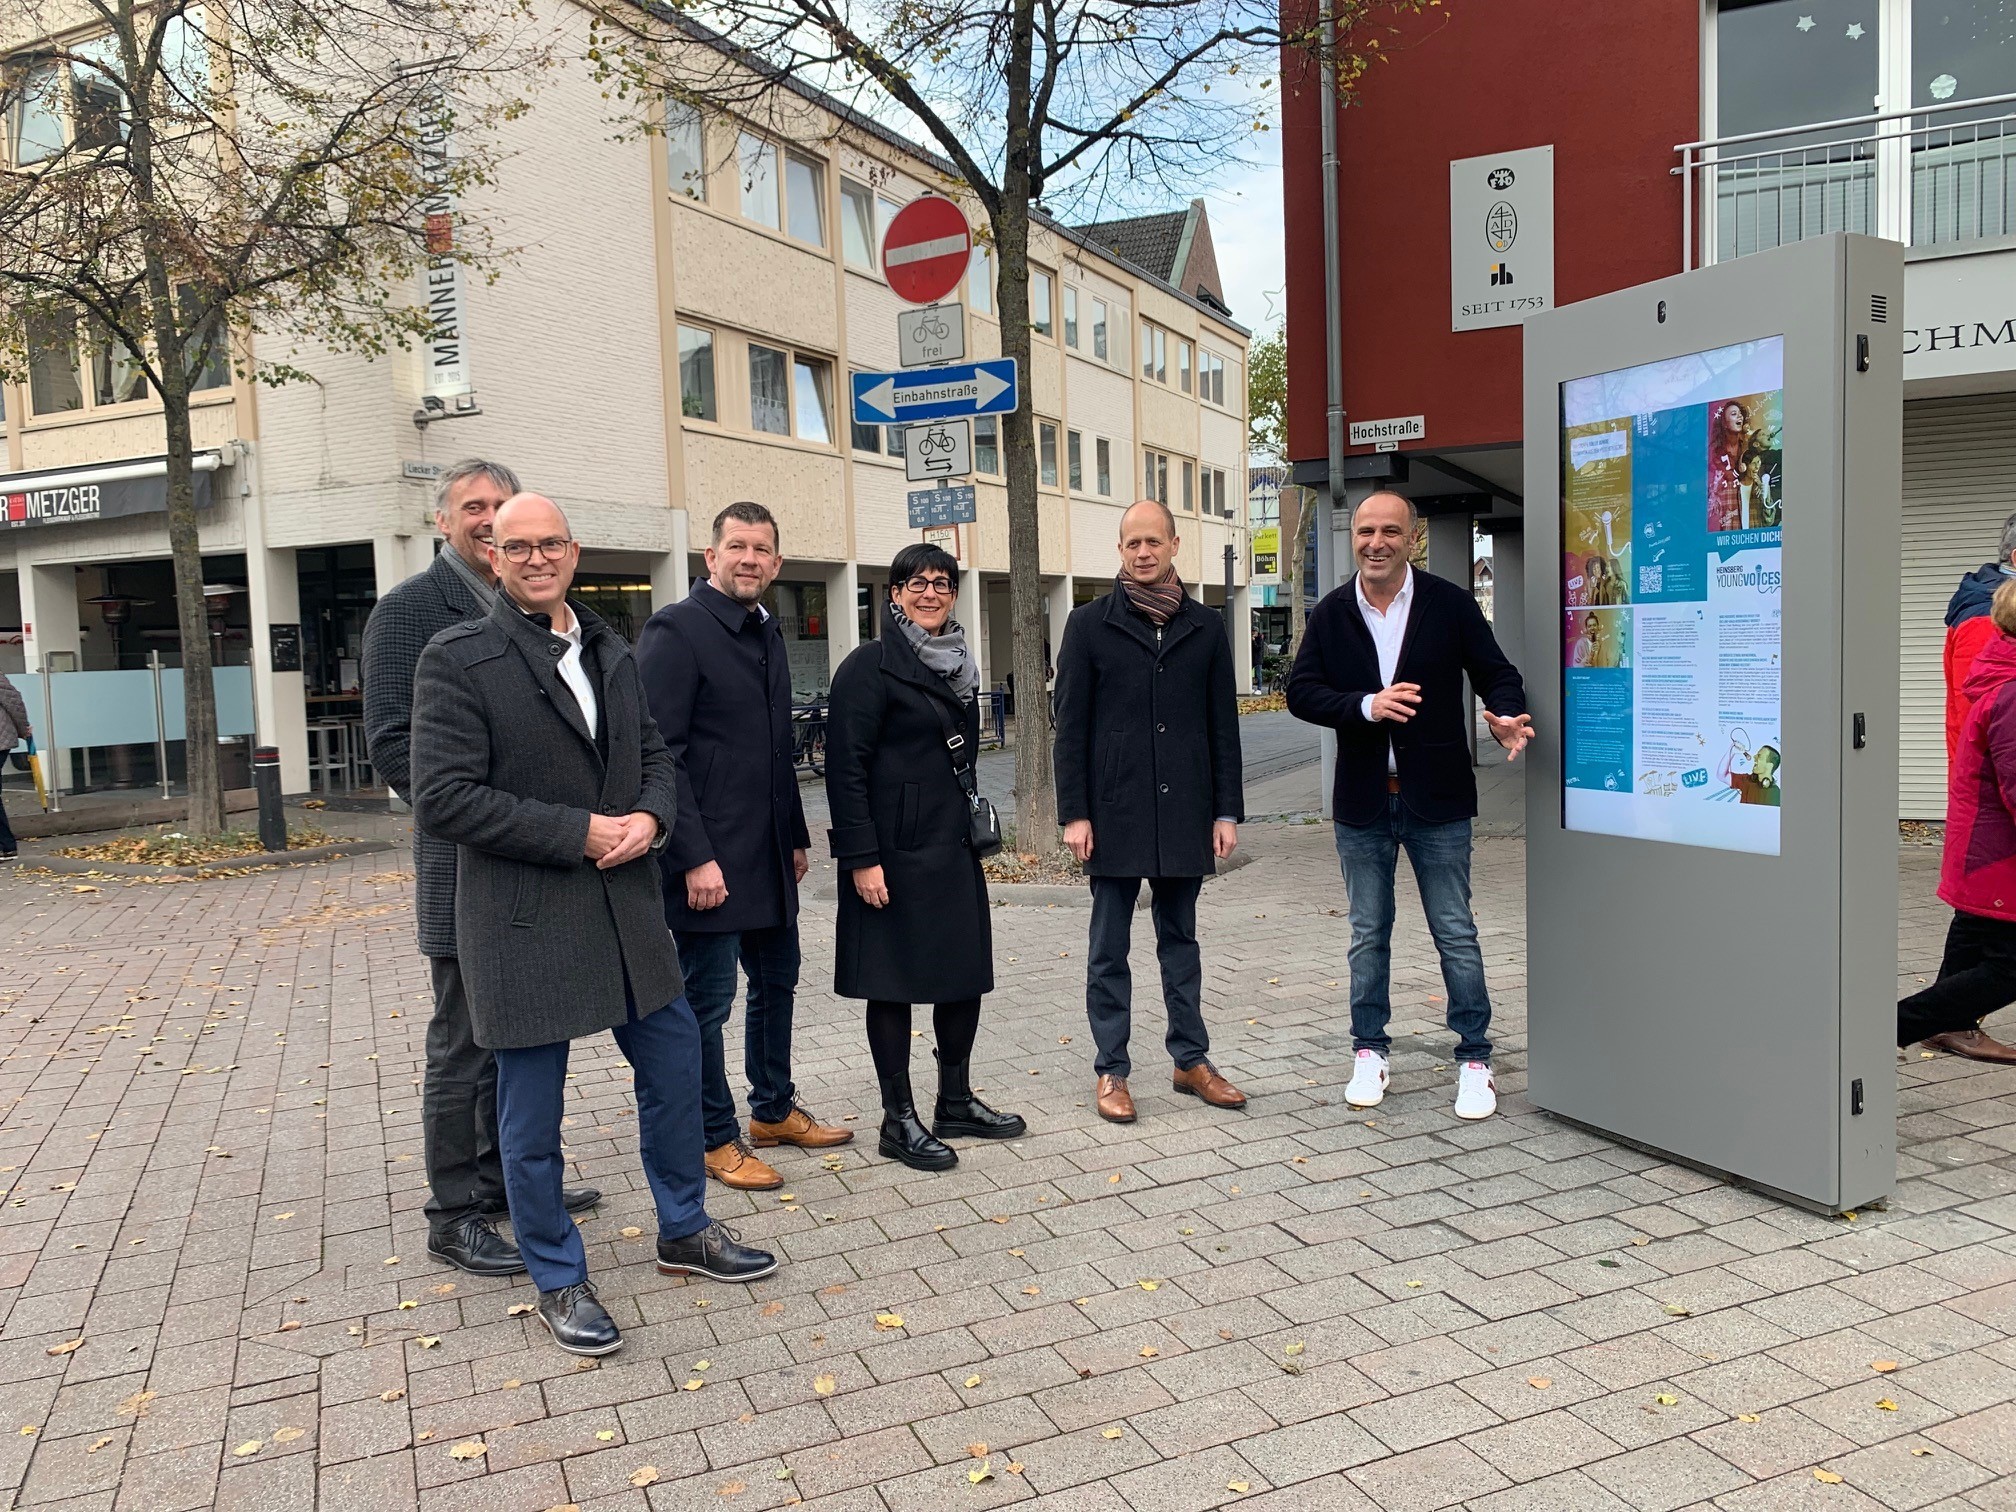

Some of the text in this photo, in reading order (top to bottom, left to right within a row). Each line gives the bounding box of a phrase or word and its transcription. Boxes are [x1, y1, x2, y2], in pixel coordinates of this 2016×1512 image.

[1461, 296, 1544, 316] SEIT 1753
[922, 344, 942, 358] frei
[893, 384, 978, 404] Einbahnstraße
[1353, 420, 1419, 439] Hochstraße
[26, 485, 100, 519] METZGER
[912, 496, 919, 504] S
[934, 494, 941, 502] S
[957, 491, 963, 500] S
[1716, 530, 1782, 547] WIR SUCHEN DICH!
[1716, 565, 1743, 574] HEINSBERG
[1683, 769, 1708, 786] LIVE
